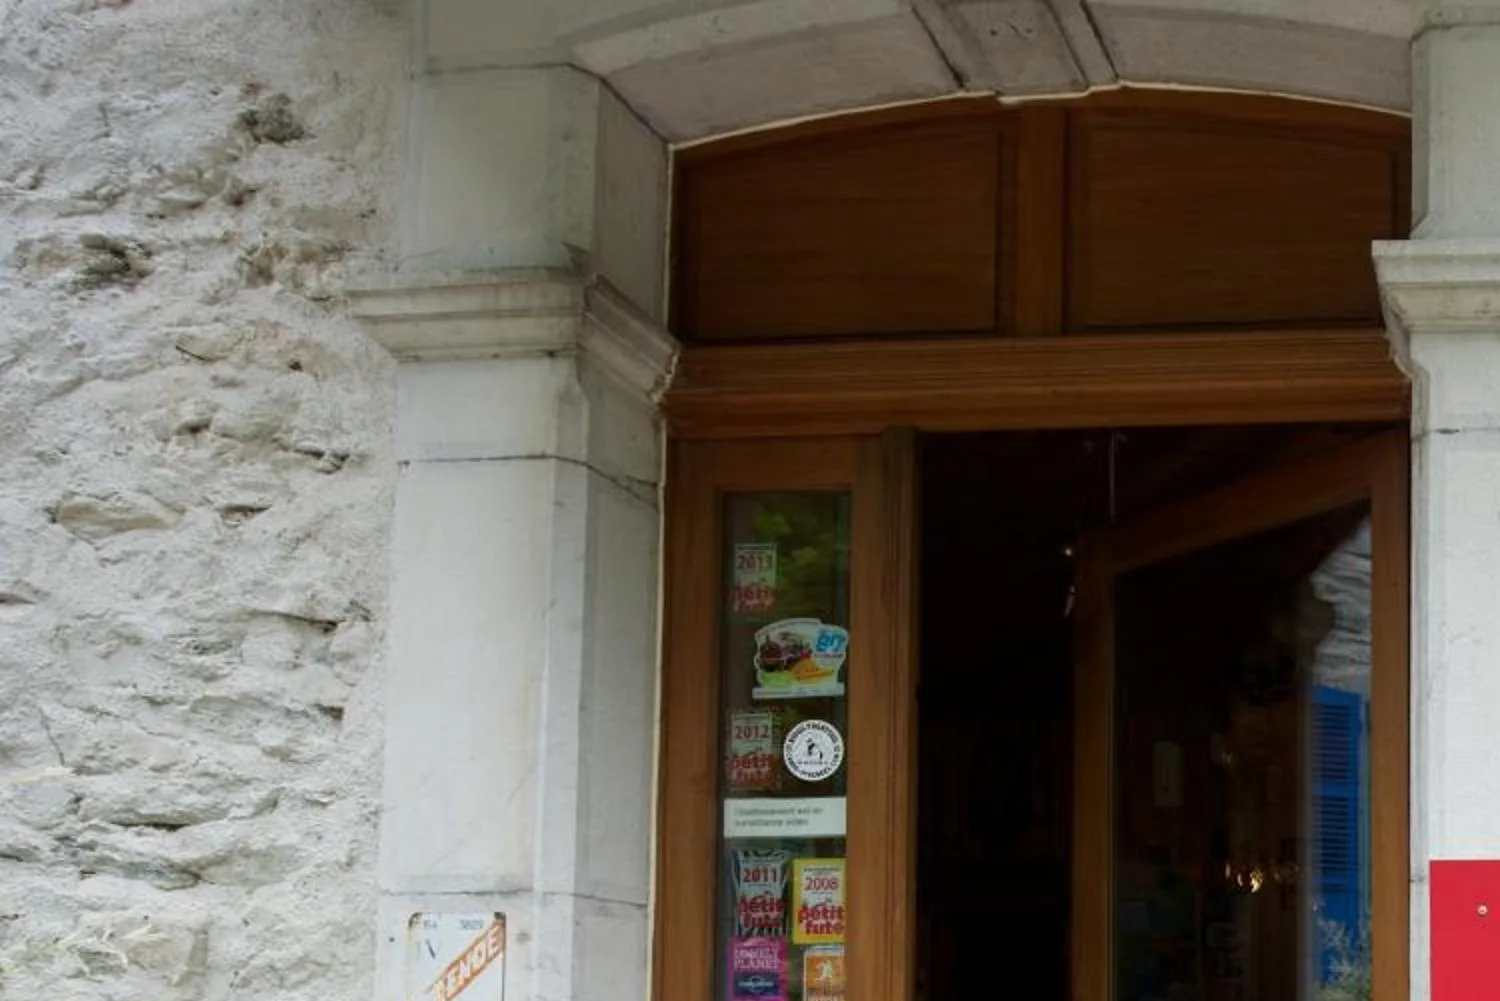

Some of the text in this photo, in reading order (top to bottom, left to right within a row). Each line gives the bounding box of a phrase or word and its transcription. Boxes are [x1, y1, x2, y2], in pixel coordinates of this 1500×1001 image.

[735, 725, 769, 740] 2012
[743, 867, 777, 882] 2011
[804, 876, 839, 890] 2008
